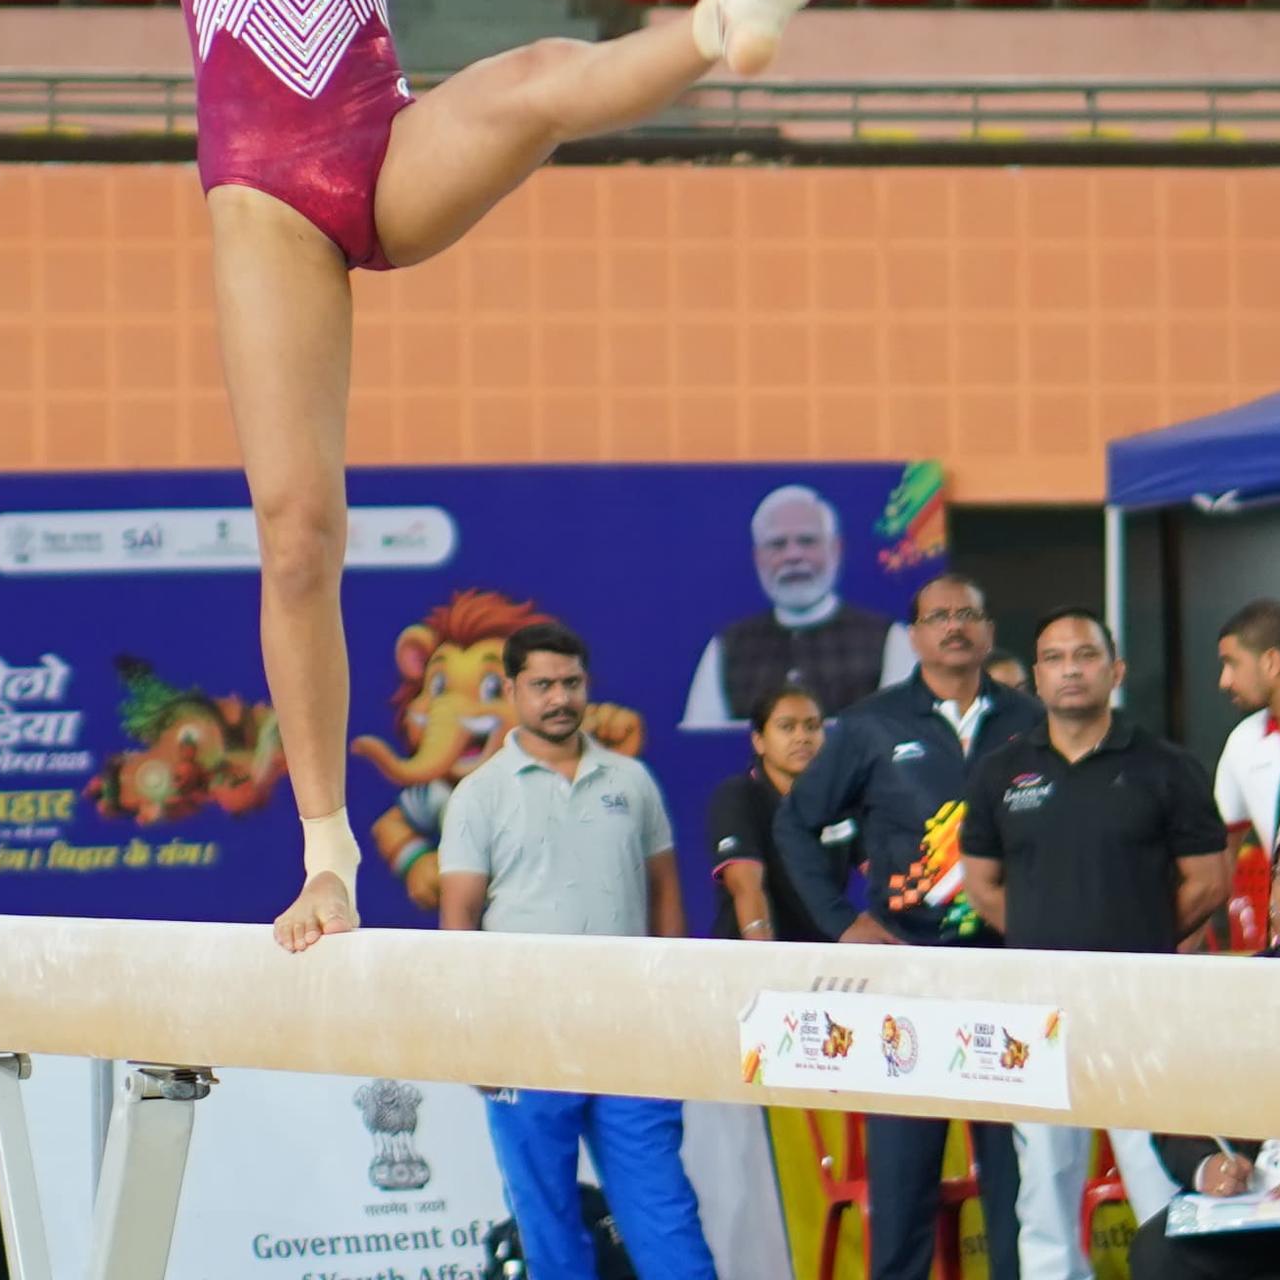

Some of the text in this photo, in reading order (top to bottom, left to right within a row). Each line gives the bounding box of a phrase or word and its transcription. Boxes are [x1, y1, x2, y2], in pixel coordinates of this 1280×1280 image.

[122, 524, 163, 550] SAI
[252, 1226, 443, 1259] Government
[451, 1220, 480, 1248] of
